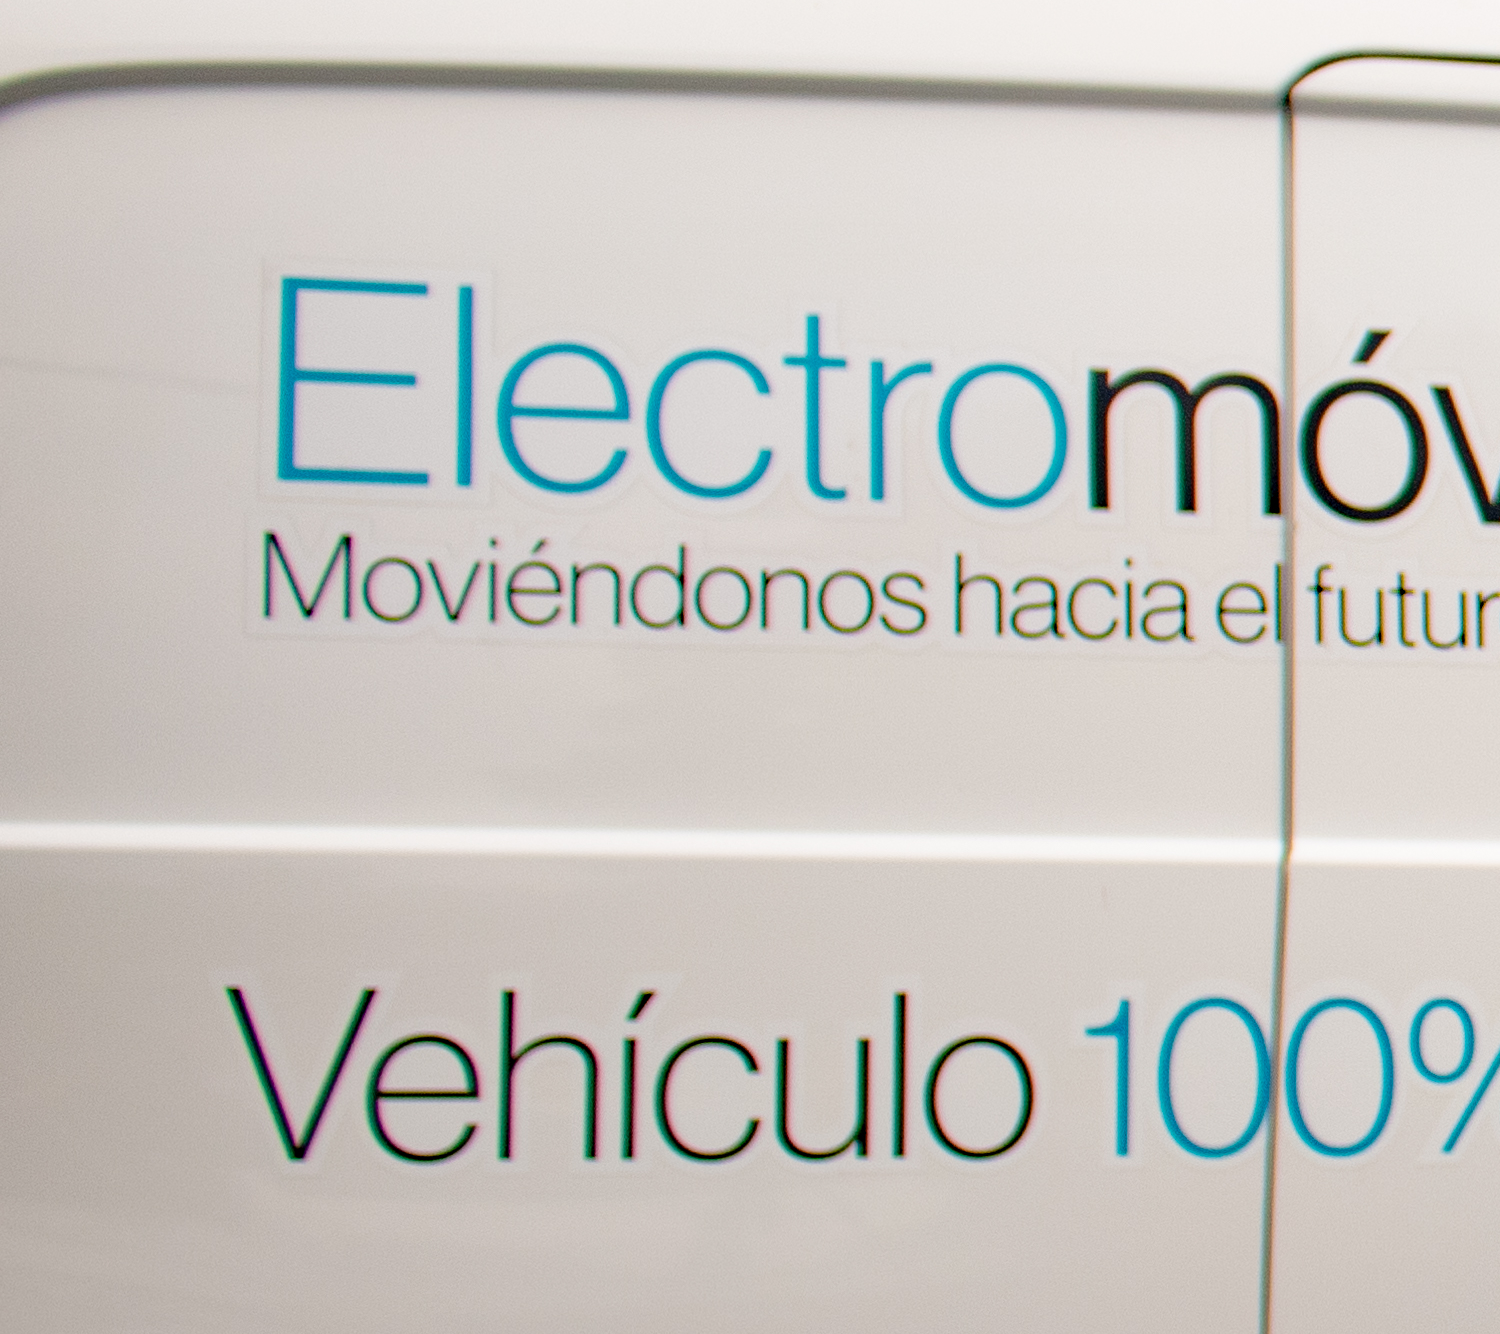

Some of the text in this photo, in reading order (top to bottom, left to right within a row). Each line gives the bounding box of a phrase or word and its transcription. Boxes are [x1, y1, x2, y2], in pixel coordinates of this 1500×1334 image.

[262, 530, 930, 634] Moviéndonos
[953, 551, 1196, 643] hacia
[1214, 563, 1287, 645] el
[223, 985, 1037, 1165] Vehículo
